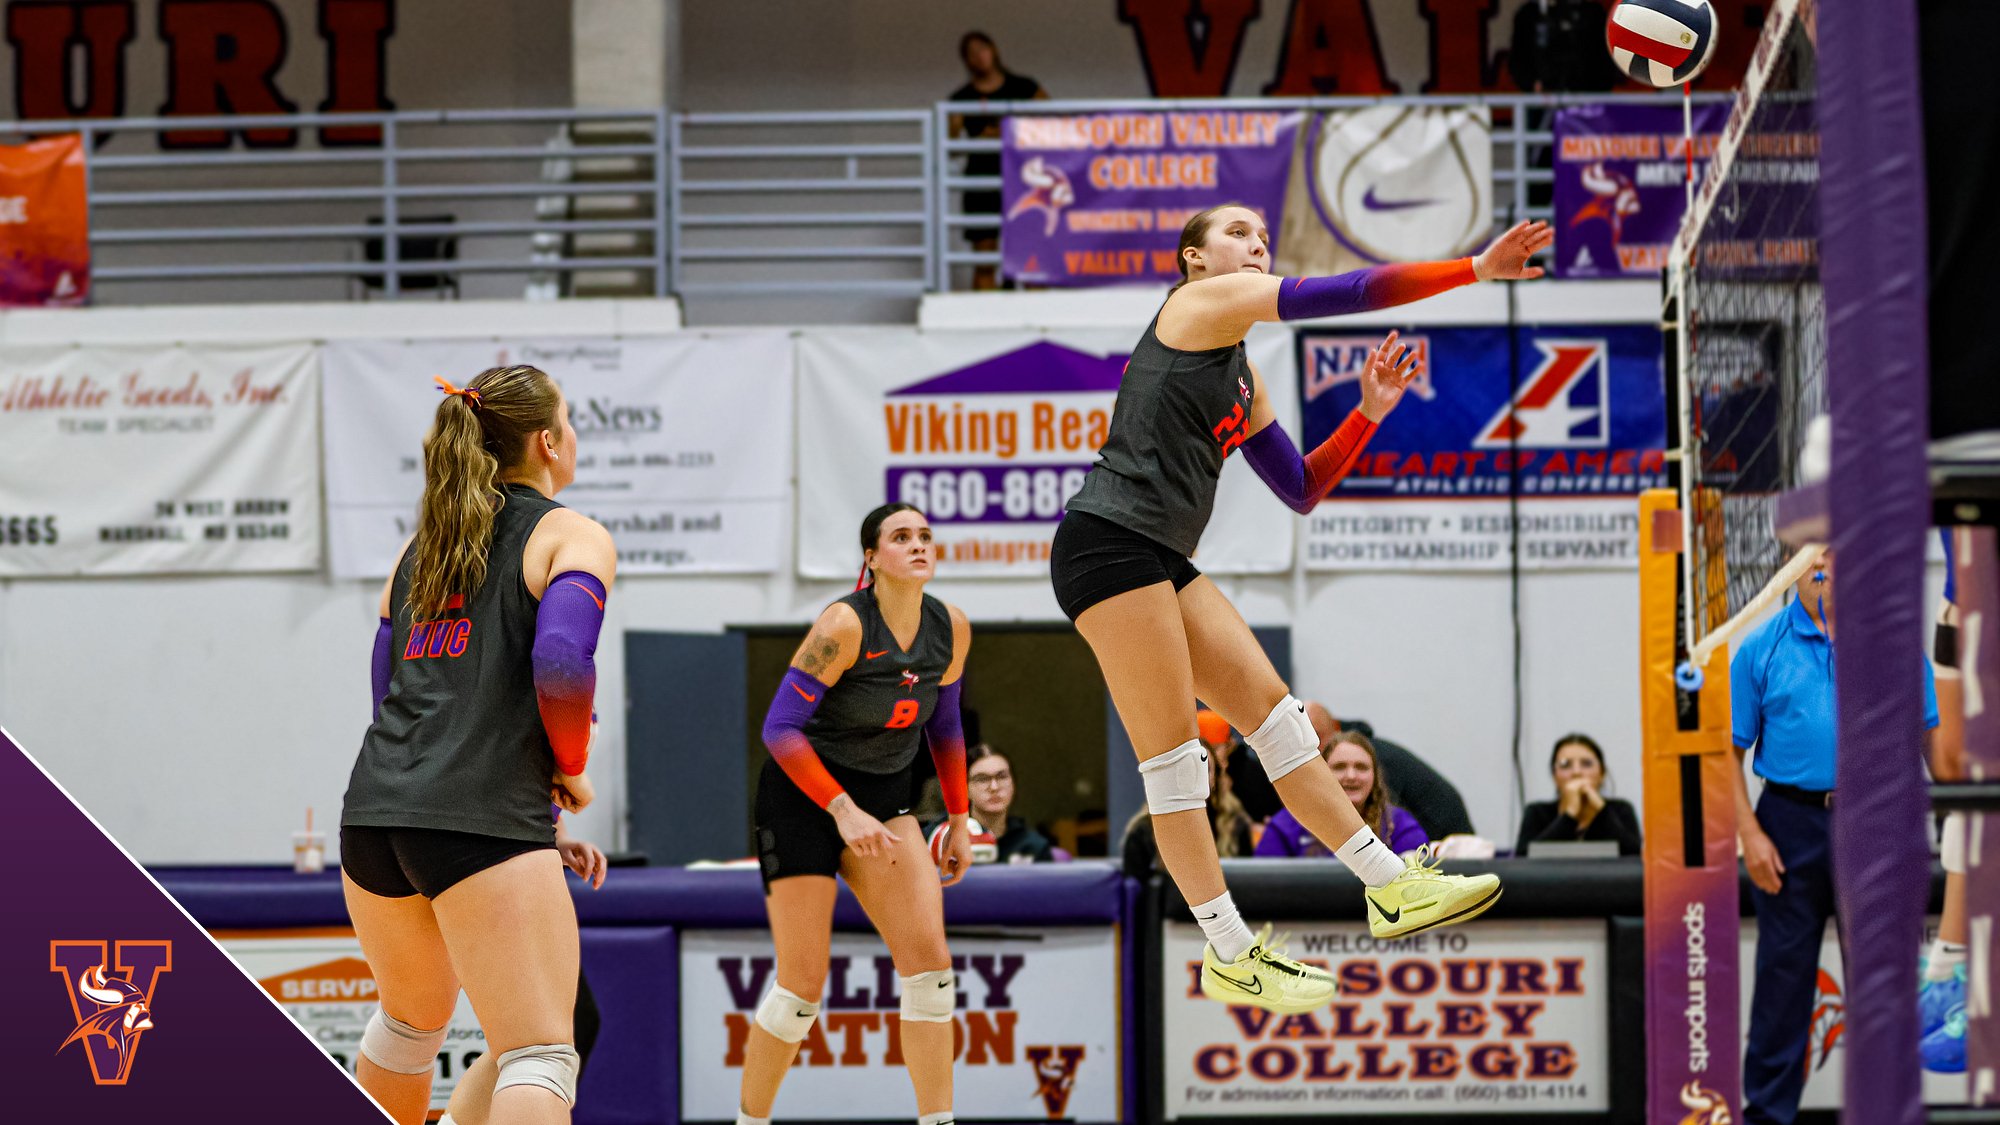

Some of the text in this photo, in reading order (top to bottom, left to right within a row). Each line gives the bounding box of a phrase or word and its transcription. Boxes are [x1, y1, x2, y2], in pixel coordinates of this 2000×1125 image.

[1013, 112, 1282, 150] MISSOURI VALLEY
[1089, 155, 1218, 188] COLLEGE
[1063, 251, 1145, 276] VALLEY
[884, 402, 1110, 458] Viking Rea
[1349, 452, 1486, 476] HEART
[1395, 475, 1668, 493] ATHLETIC CONFERENC
[682, 512, 722, 531] and
[1310, 515, 1431, 534] INTEGRITY
[1308, 541, 1499, 561] SPORTSMANSHIP
[403, 618, 472, 660] MVC
[884, 699, 919, 729] 8
[1303, 933, 1468, 953] WELCOME TO
[281, 978, 378, 998] SERVP
[717, 954, 1025, 1010] VLLY
[1187, 958, 1585, 998] SOURI
[1682, 902, 1711, 1073] sports imports
[1227, 1002, 1546, 1040] VALLEY
[724, 1011, 1018, 1068] NATIN
[1193, 1043, 1578, 1083] COLLEGE
[1186, 1087, 1216, 1102] For
[1221, 1086, 1308, 1101] admission
[1313, 1086, 1410, 1101] information
[1454, 1085, 1588, 1102] (660)-831-4114
